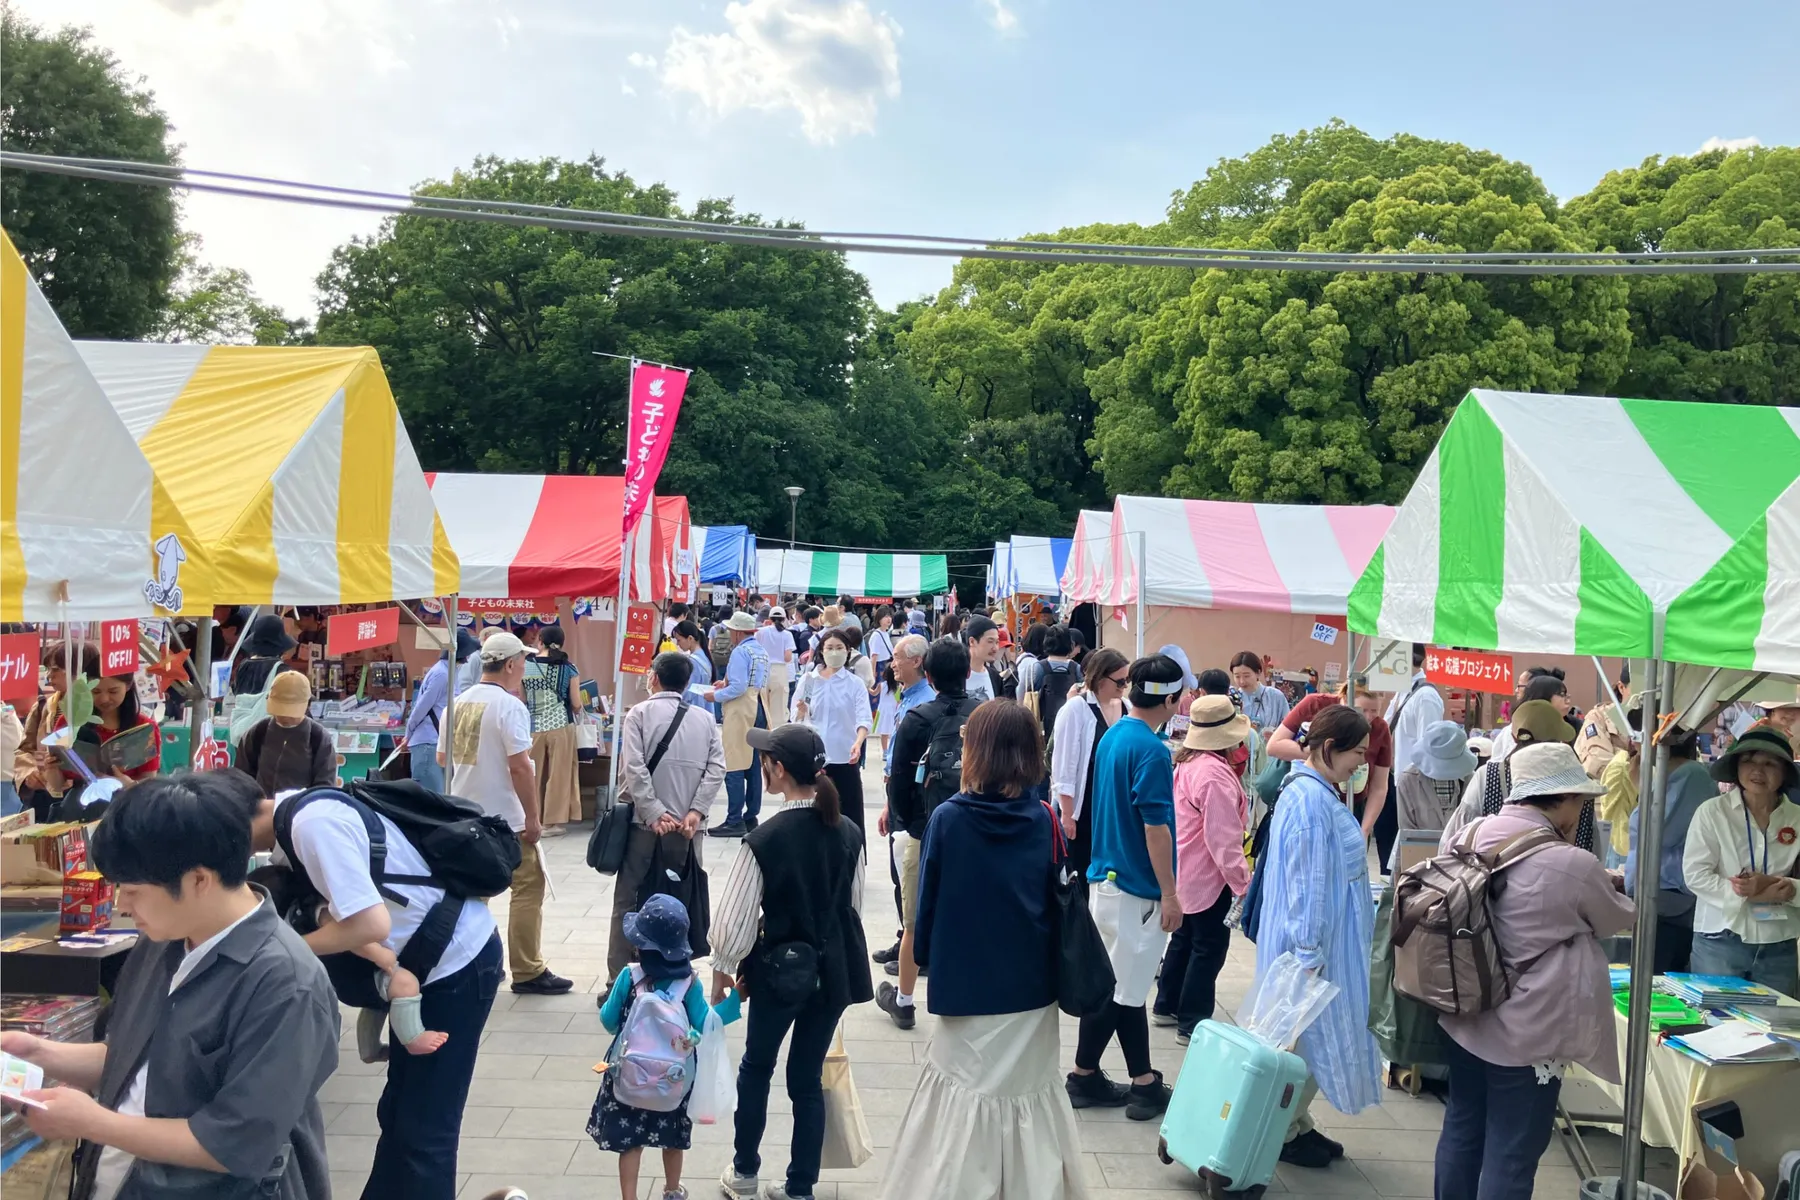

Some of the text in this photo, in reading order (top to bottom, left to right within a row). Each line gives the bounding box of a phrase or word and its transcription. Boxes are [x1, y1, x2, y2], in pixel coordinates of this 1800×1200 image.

[713, 591, 727, 600] 30
[467, 598, 535, 609] 子どもの未来社
[591, 596, 612, 611] 47
[110, 624, 131, 643] 10%
[1315, 623, 1334, 634] 10%
[1313, 631, 1333, 642] OFF
[108, 649, 133, 669] OFF!!
[621, 665, 646, 673] WELCOME
[1426, 653, 1511, 682] 絵本・応援プロジェクト
